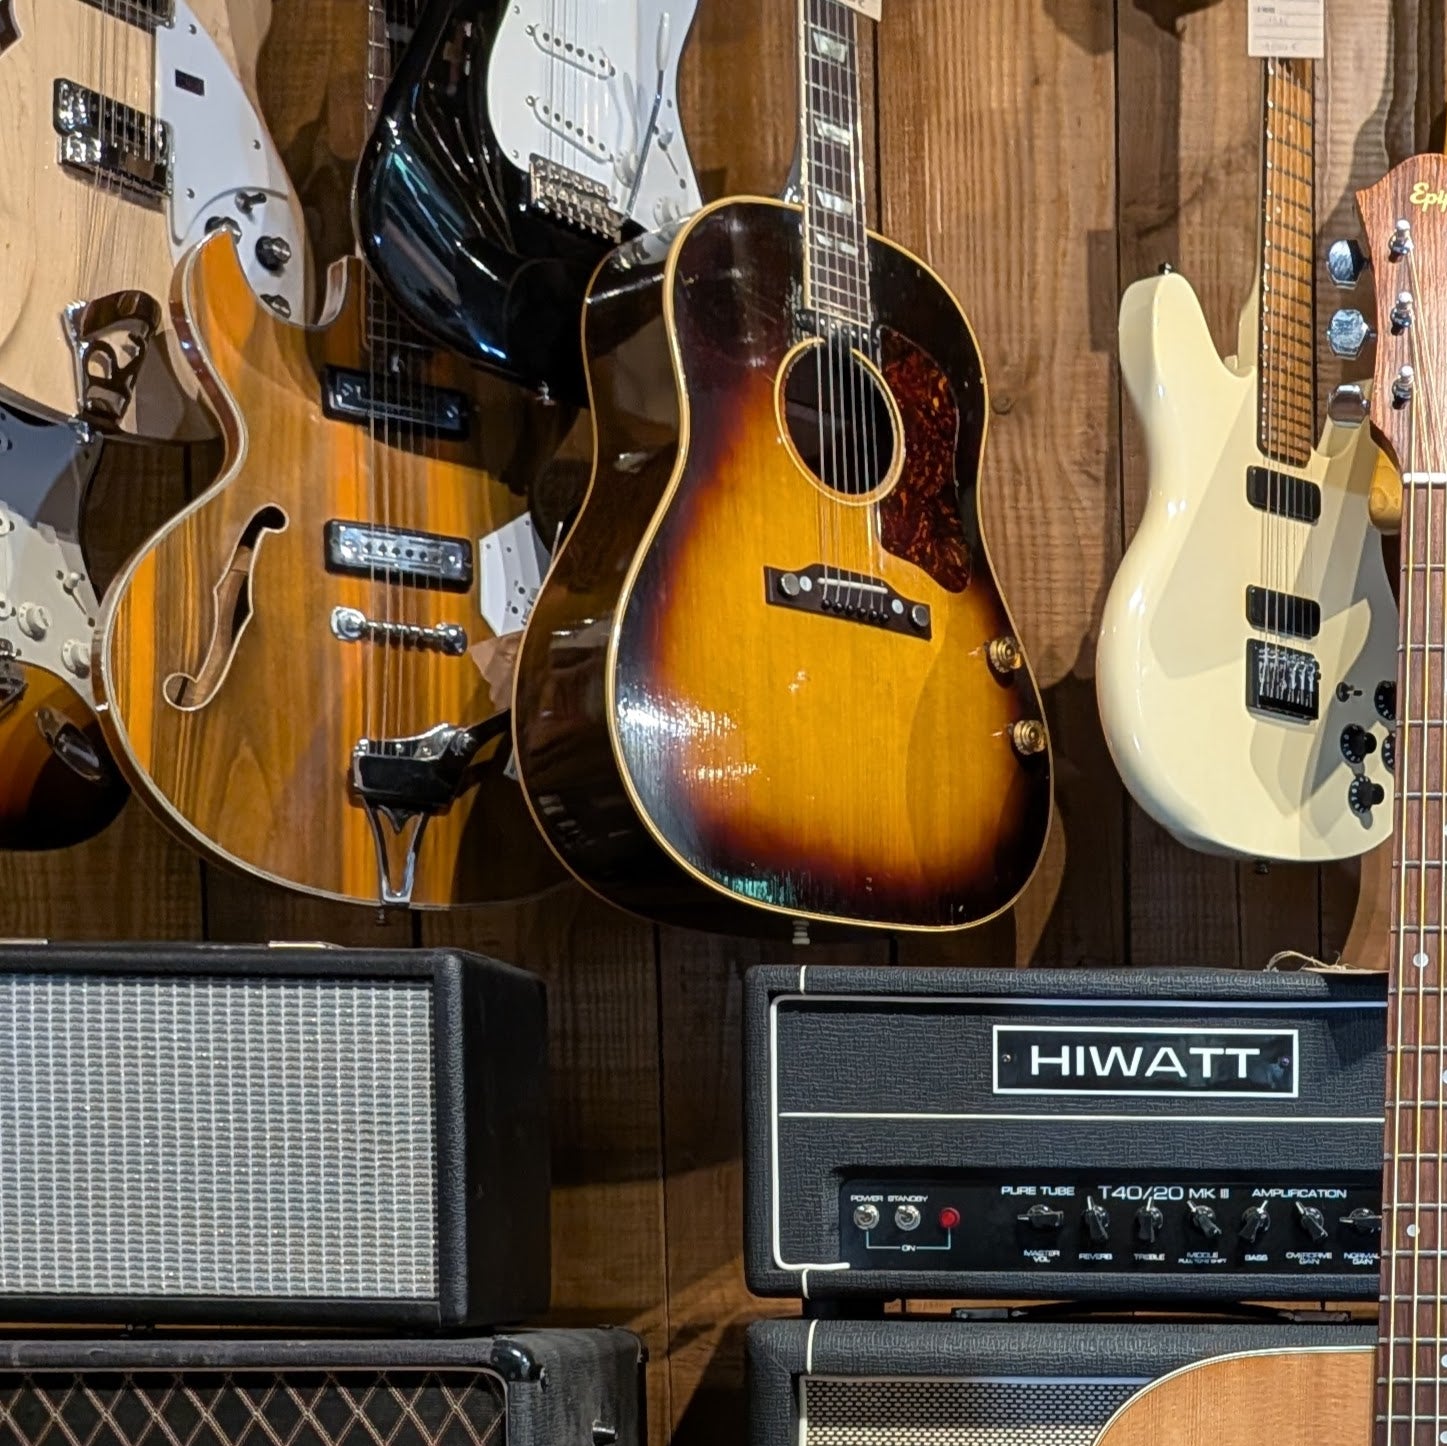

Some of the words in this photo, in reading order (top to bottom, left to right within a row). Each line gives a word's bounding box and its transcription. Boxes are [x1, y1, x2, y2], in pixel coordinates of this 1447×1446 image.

[1031, 1045, 1260, 1079] HIWATT
[1001, 1186, 1036, 1196] PURE
[1040, 1186, 1075, 1196] TUBE
[1098, 1185, 1184, 1200] T40/20
[1189, 1188, 1215, 1199] MK
[1252, 1188, 1347, 1199] AMPLIFICATION
[1134, 1253, 1165, 1261] TREBLE
